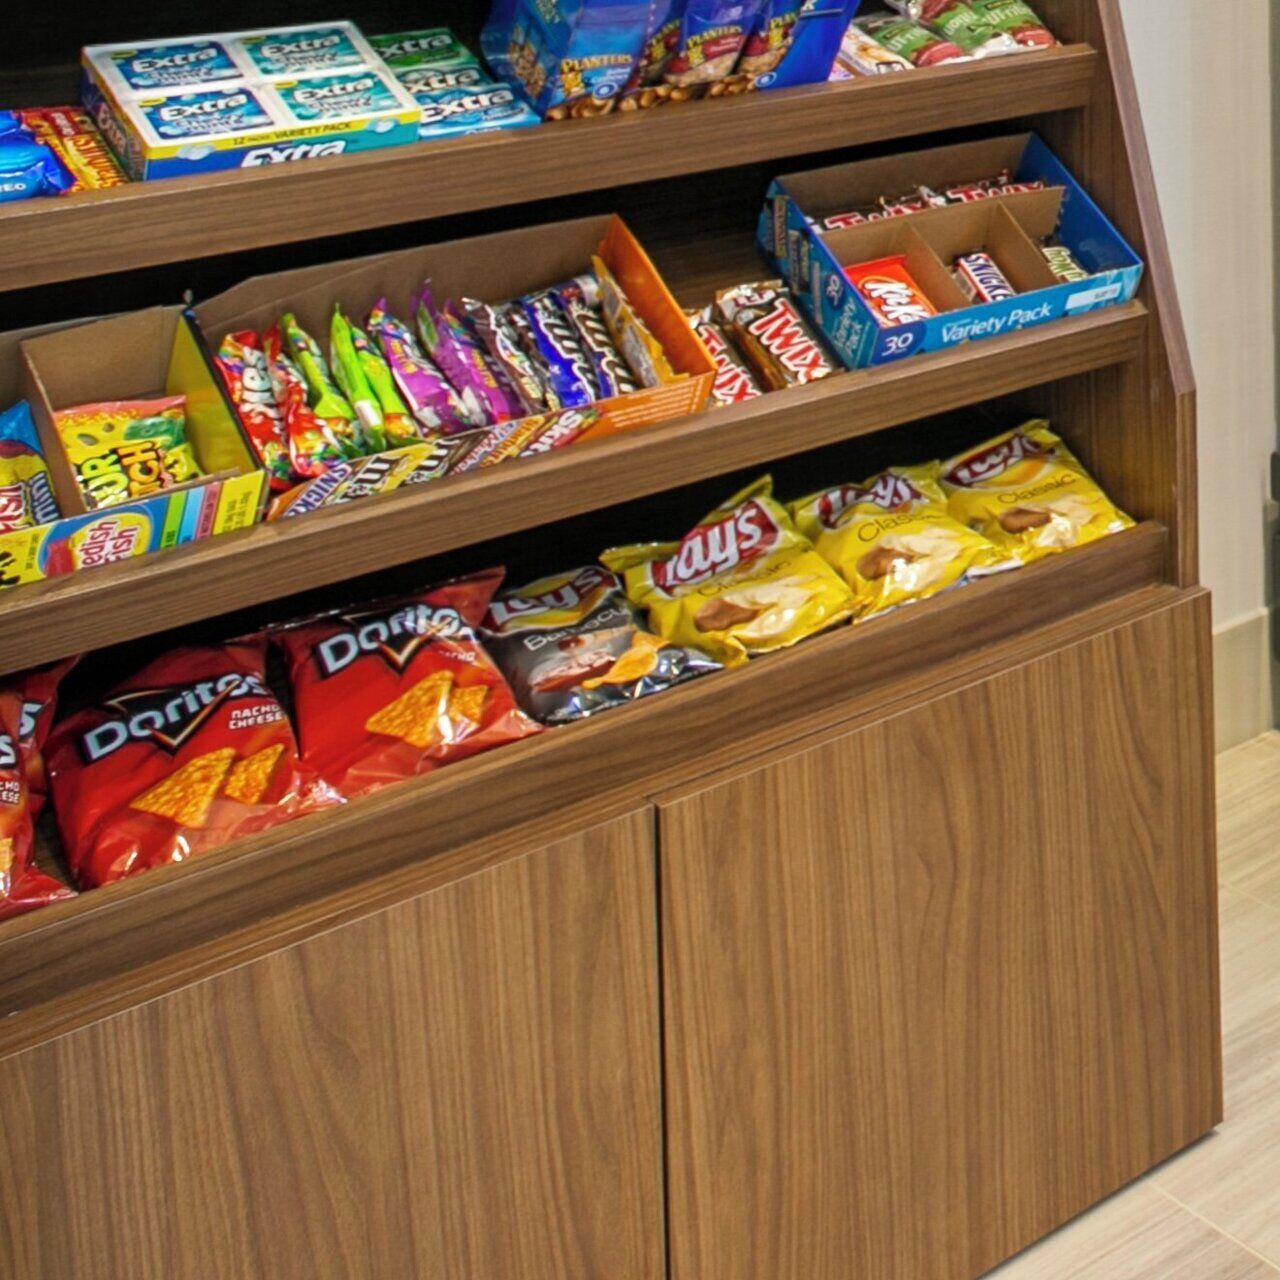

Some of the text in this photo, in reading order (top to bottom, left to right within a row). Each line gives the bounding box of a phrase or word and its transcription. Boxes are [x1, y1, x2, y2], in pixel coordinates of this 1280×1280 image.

[261, 35, 342, 58] Extra
[378, 34, 453, 60] xtra
[687, 25, 742, 49] PLANTERS
[131, 48, 218, 73] Extra
[560, 53, 633, 73] PLANTERS
[293, 74, 376, 104] Extra
[402, 69, 480, 95] xtra
[160, 94, 248, 121] Extra
[420, 89, 514, 126] Extra
[233, 122, 351, 146] 12 VARIETY PACK
[240, 139, 346, 169] Extra
[941, 302, 1053, 344] Variety Pack
[748, 298, 833, 385] TWIX
[881, 332, 915, 357] 30
[996, 472, 1077, 505] Classic
[80, 520, 118, 566] edish
[666, 508, 762, 587] Lay's
[83, 672, 269, 761] Doritos
[228, 711, 283, 730] CHEESE
[231, 703, 281, 719] NACHO
